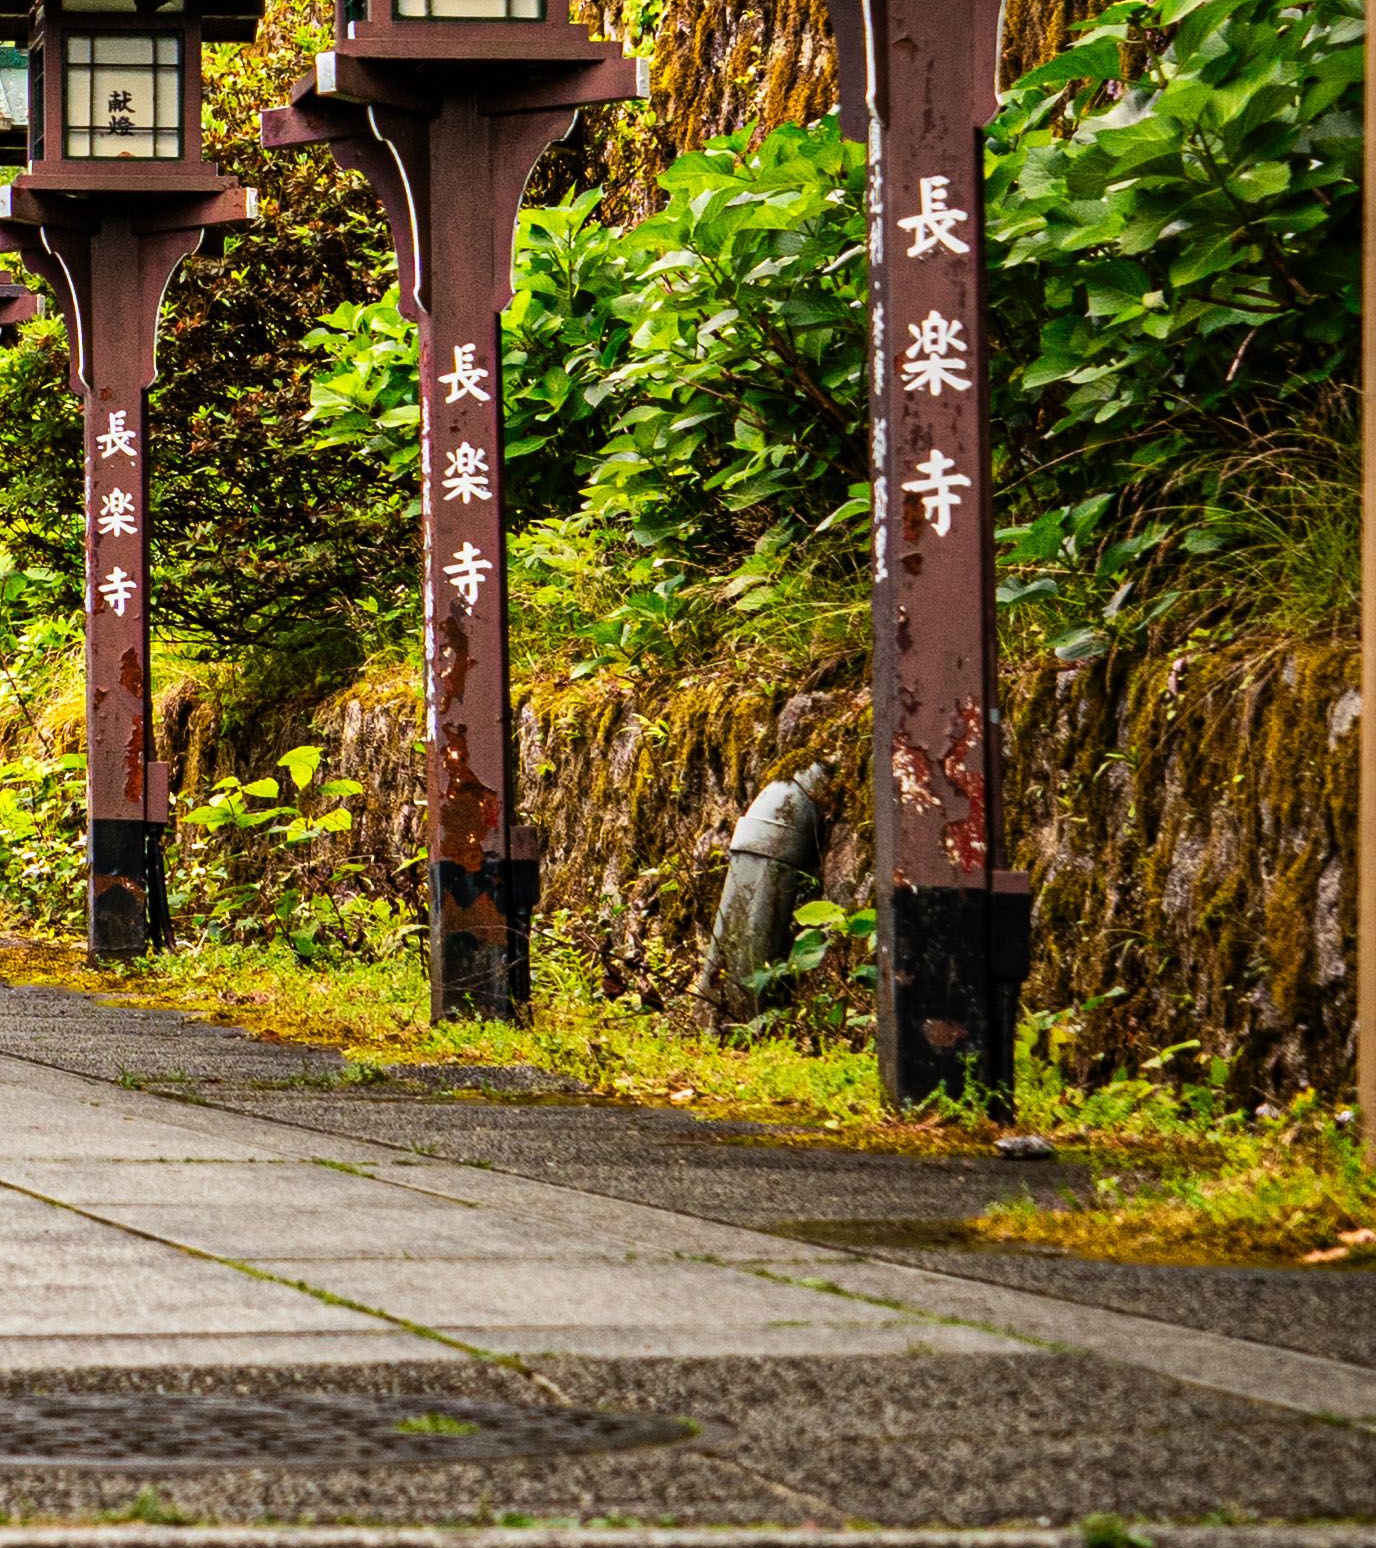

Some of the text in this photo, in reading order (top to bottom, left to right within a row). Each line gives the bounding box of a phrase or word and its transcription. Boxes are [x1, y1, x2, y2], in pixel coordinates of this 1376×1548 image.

[108, 90, 136, 136] 献燈
[897, 175, 973, 538] 長楽寺
[96, 409, 138, 617] 長楽寺
[437, 343, 494, 615] 長楽寺
